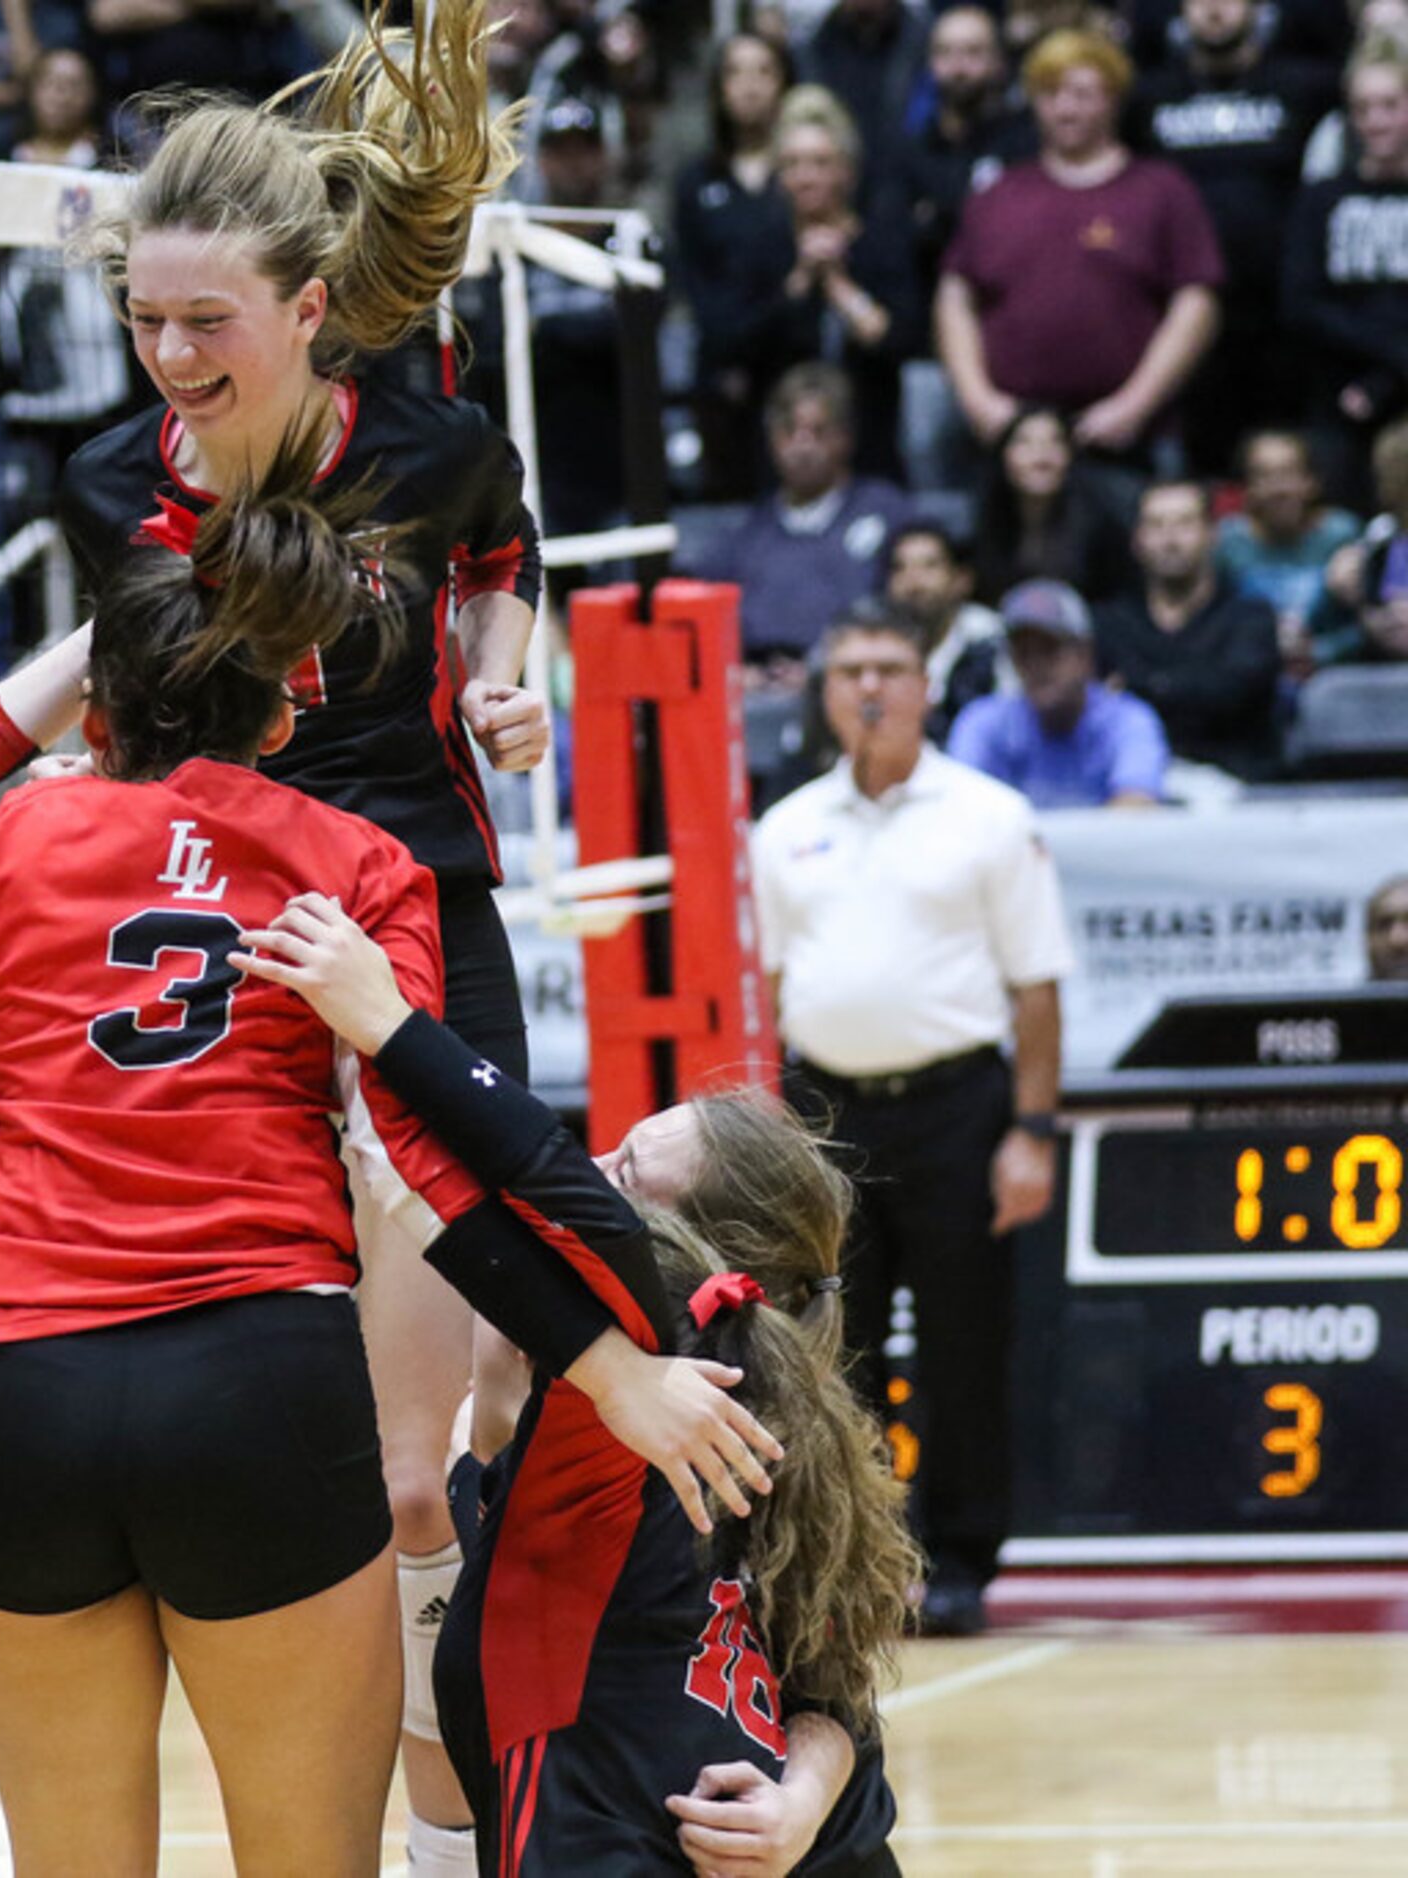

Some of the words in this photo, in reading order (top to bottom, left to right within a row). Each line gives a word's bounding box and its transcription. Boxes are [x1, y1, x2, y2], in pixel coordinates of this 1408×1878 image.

[1084, 902, 1215, 940] TEXAS
[1232, 897, 1348, 935] FARM
[87, 907, 257, 1081] 3
[1200, 1305, 1380, 1367] PERIOD
[1259, 1382, 1324, 1498] 3
